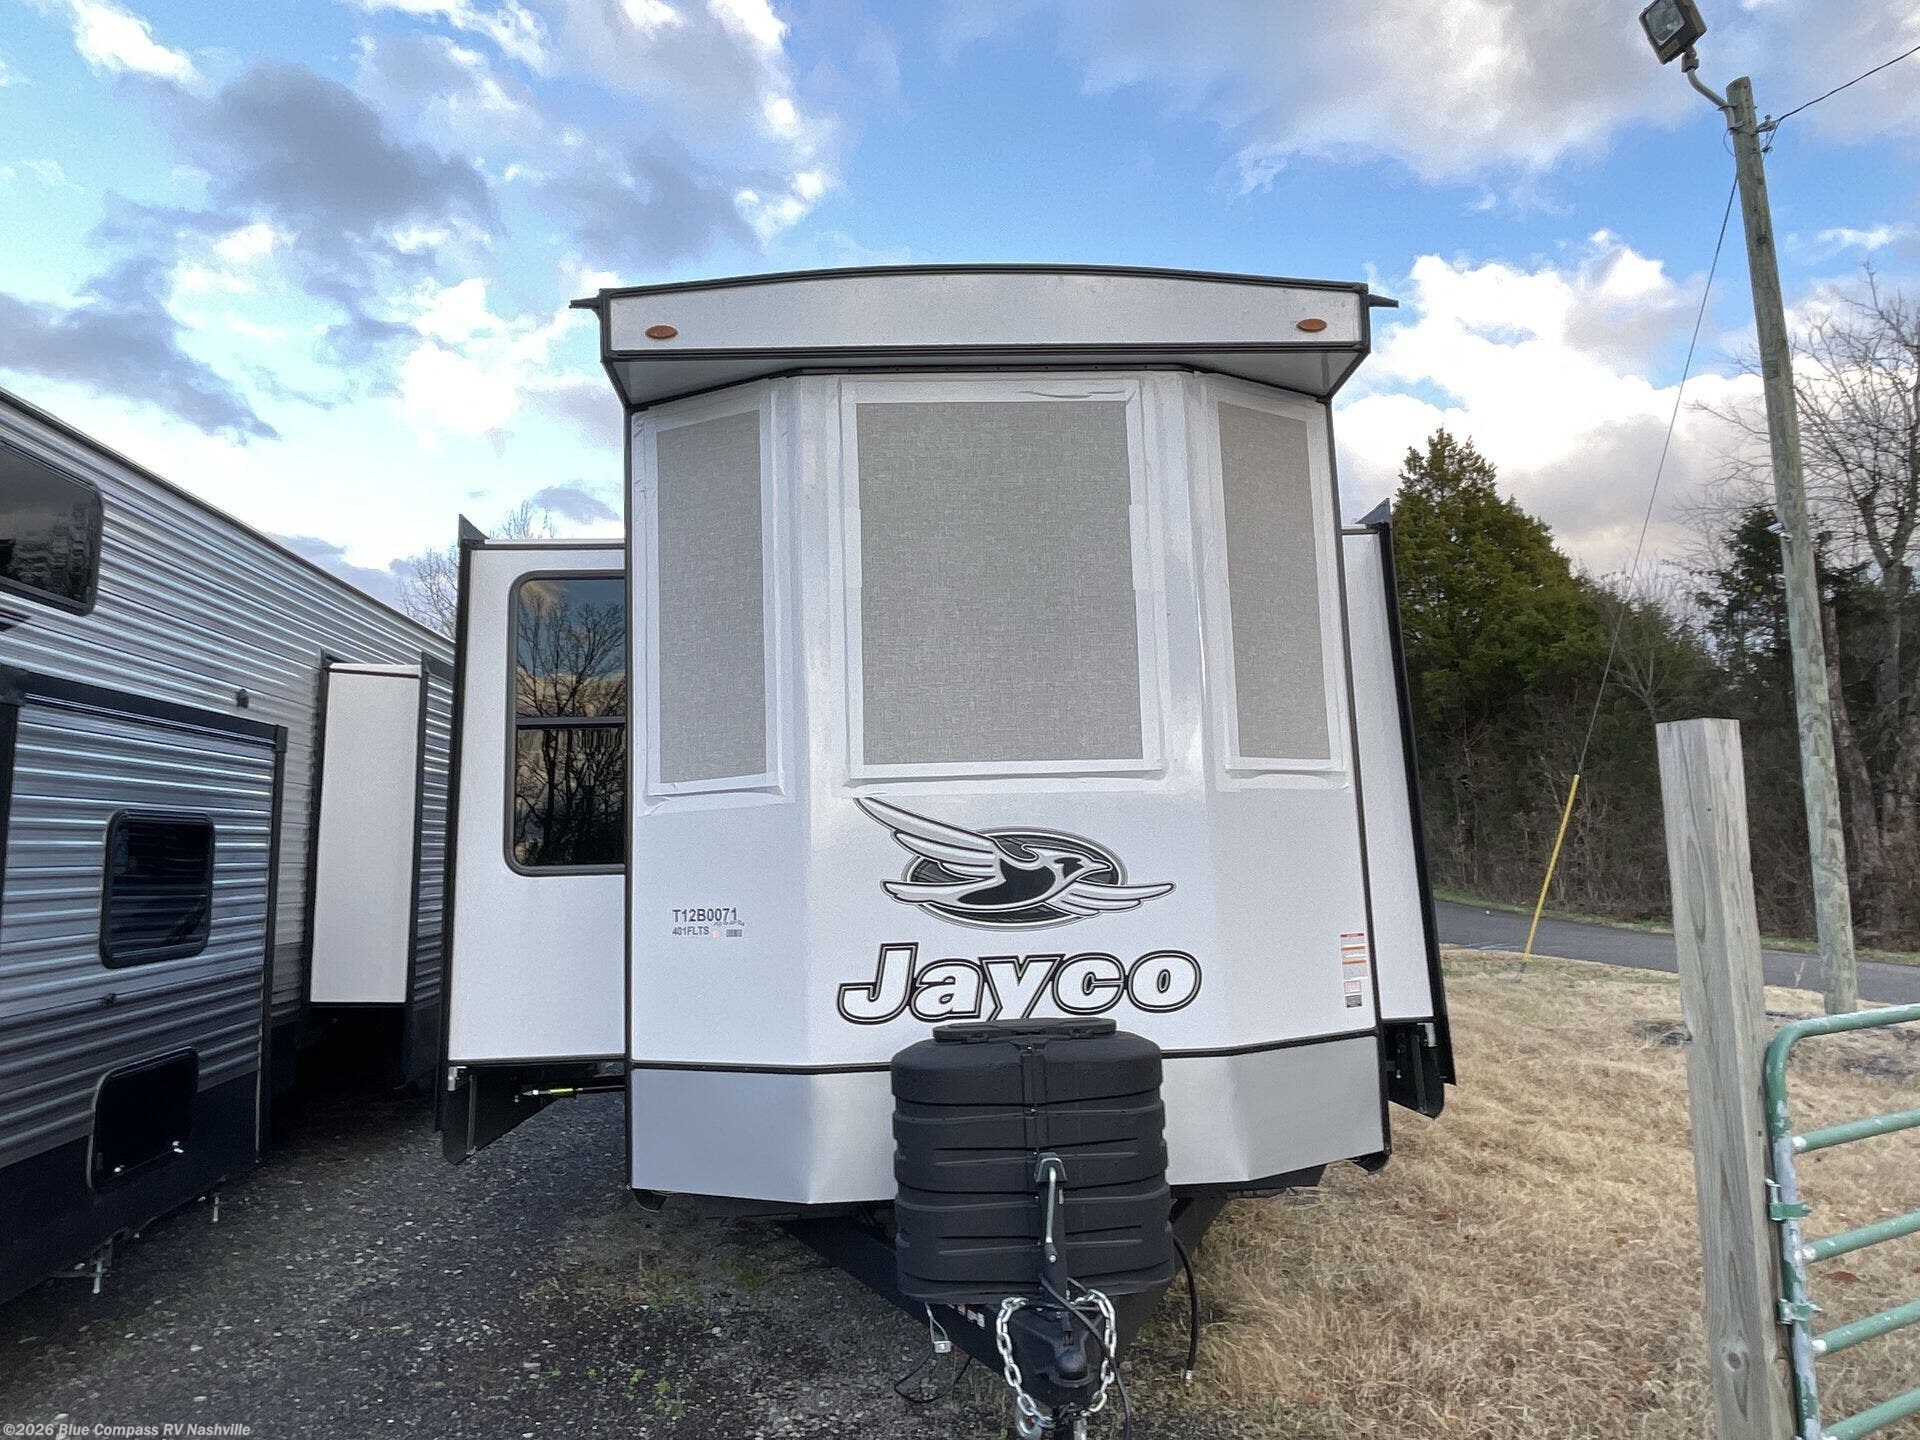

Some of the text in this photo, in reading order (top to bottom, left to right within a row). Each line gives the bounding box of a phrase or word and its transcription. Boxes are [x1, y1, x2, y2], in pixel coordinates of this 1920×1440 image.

[672, 907, 737, 922] T12B0071
[672, 926, 710, 936] 401FLTS
[836, 942, 1202, 1025] Jayco
